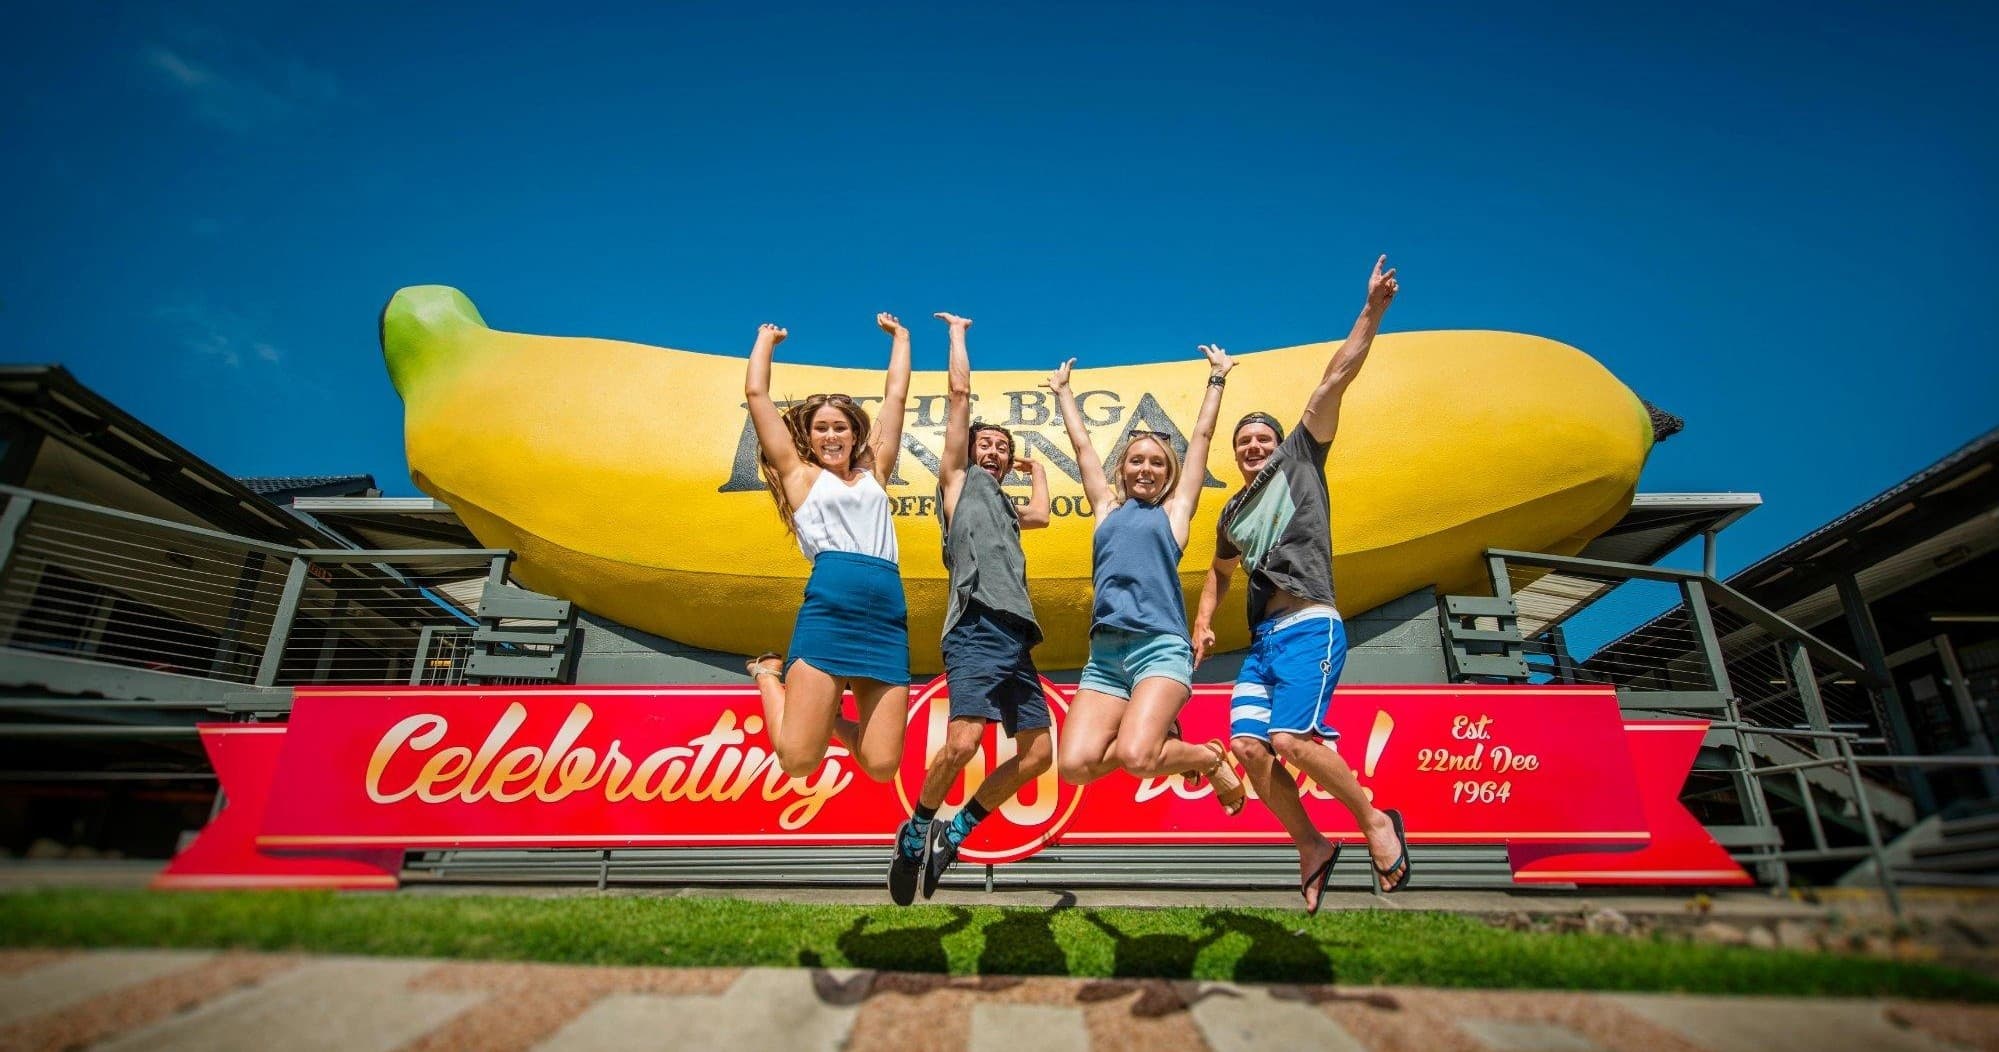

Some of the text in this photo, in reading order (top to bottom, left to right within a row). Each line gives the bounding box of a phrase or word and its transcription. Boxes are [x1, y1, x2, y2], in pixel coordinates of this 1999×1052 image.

[1002, 390, 1126, 427] BIG
[1451, 714, 1494, 740] Est.
[365, 701, 854, 831] Celebrating
[1416, 742, 1540, 774] 22nd Dec
[1452, 780, 1512, 804] 1964
